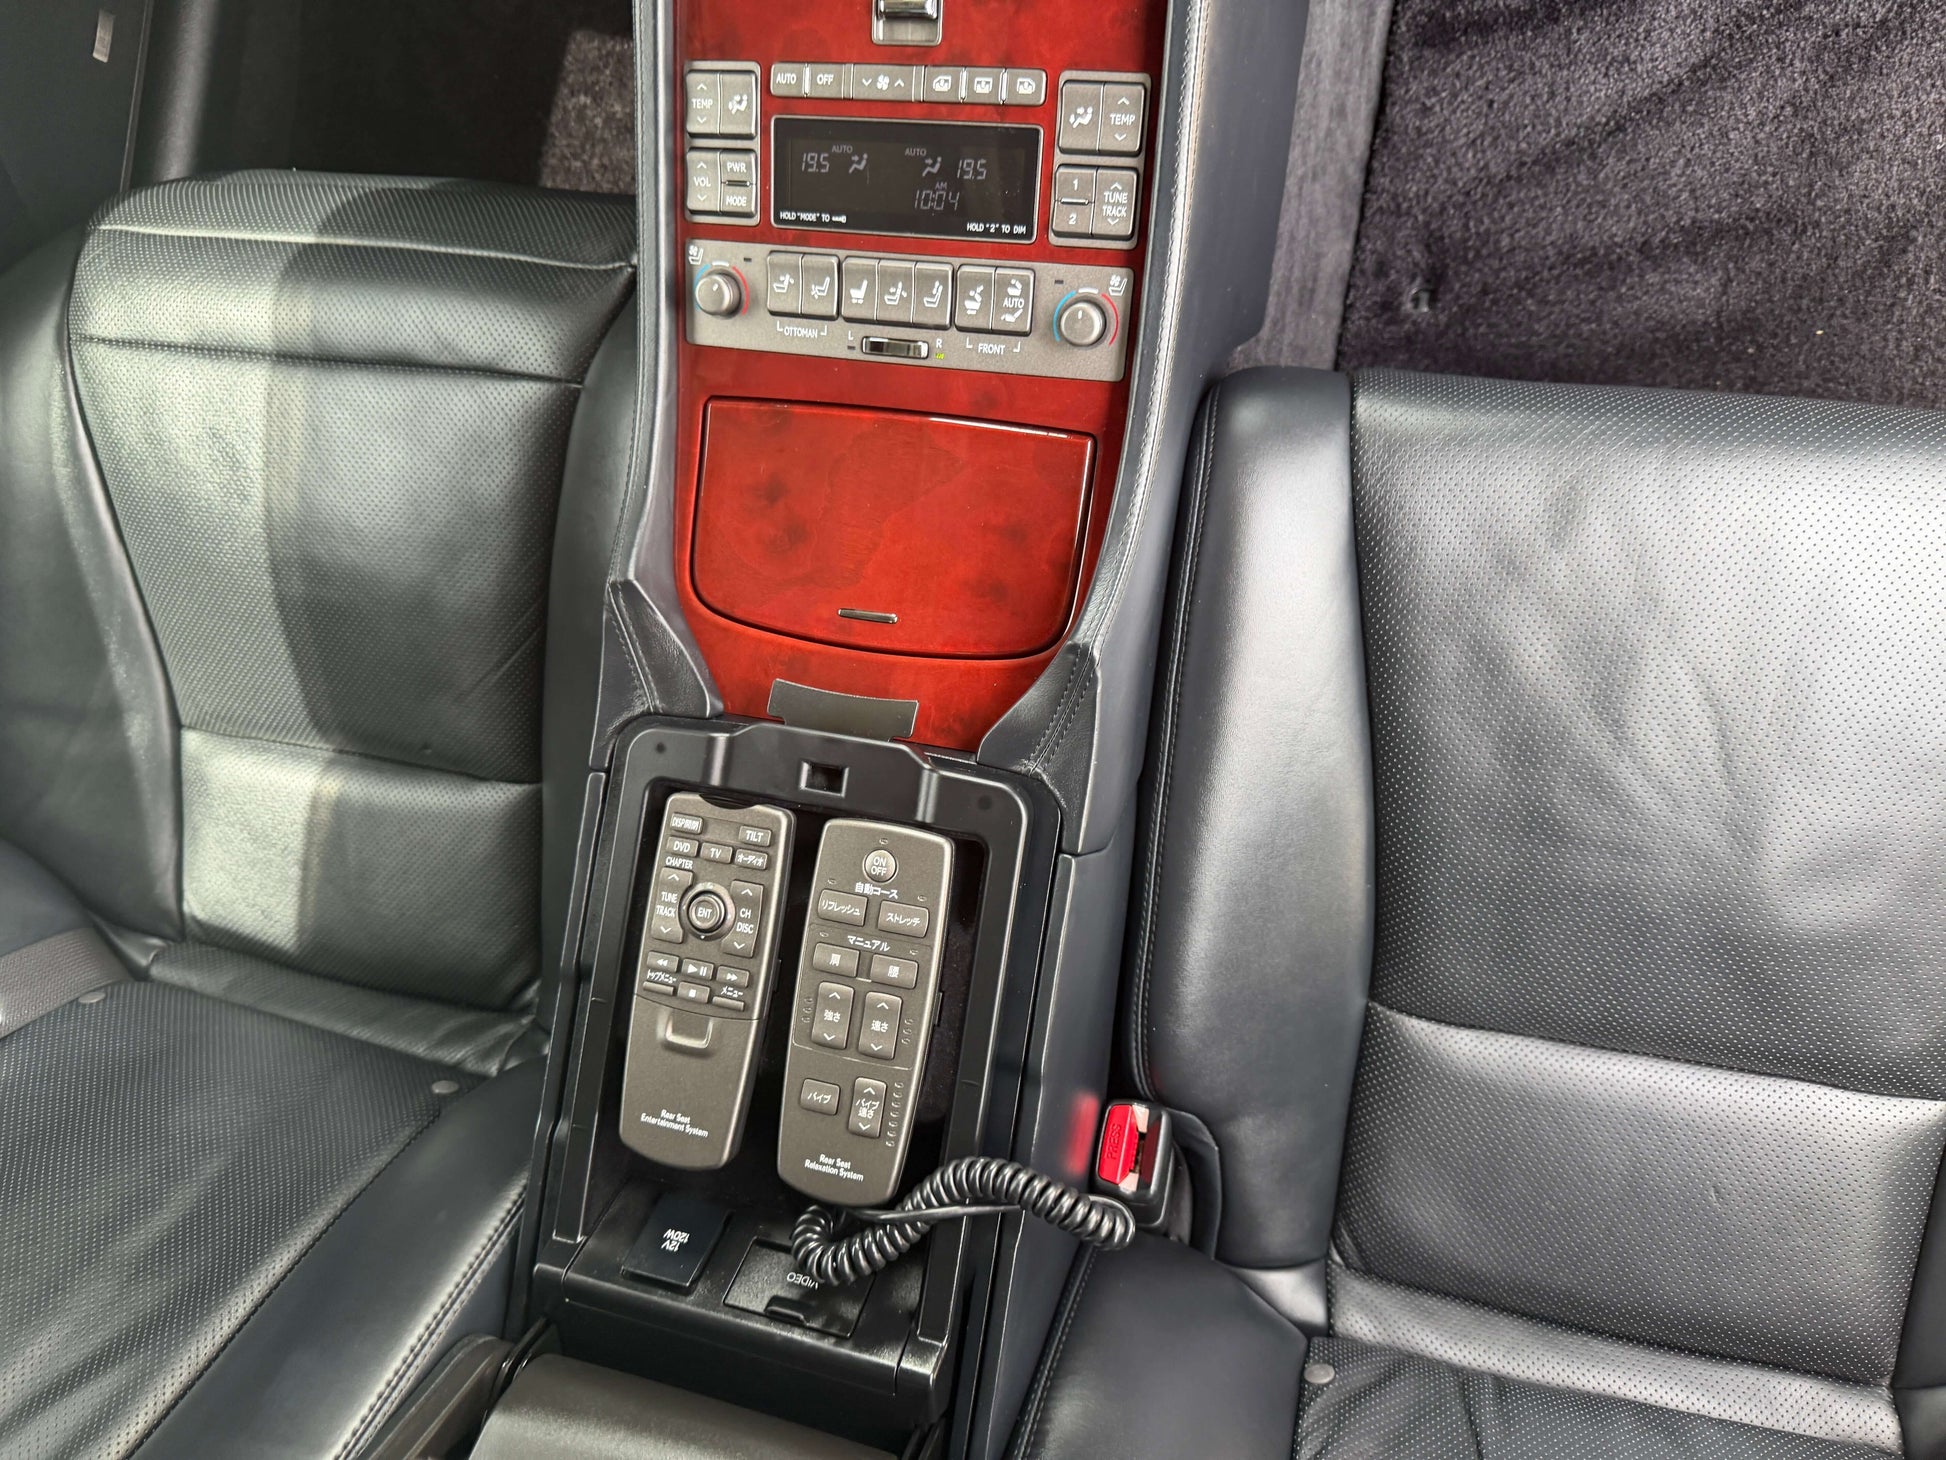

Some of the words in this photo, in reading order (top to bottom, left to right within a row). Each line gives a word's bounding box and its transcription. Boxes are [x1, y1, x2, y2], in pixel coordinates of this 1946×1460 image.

[776, 73, 796, 84] AUTO
[817, 74, 834, 85] OFF
[692, 98, 713, 110] TEMP
[1110, 113, 1135, 126] TEMP
[832, 145, 853, 154] AUTO
[905, 148, 927, 157] AUTO
[727, 161, 746, 172] PWR
[694, 176, 711, 187] VOL
[935, 182, 947, 190] AM
[1072, 179, 1079, 191] 1
[726, 195, 747, 206] MODE
[915, 190, 959, 211] 10:04
[1104, 192, 1128, 204] TUNE
[780, 211, 796, 221] HOLD
[821, 213, 830, 222] TO
[1102, 206, 1127, 218] TRACK
[1069, 214, 1077, 225] 2
[967, 223, 984, 232] HOLD
[1002, 224, 1010, 233] TO
[1013, 225, 1026, 234] DIM
[1003, 297, 1024, 308] AUTO
[784, 327, 818, 339] OTTOMAN
[936, 339, 942, 348] R
[978, 343, 1006, 355] FRONT
[746, 830, 764, 842] TILT
[674, 841, 691, 852] DVD
[710, 848, 722, 858] TV
[666, 856, 693, 870] CHAPTER
[873, 857, 886, 867] ON
[870, 866, 887, 876] OFF
[855, 881, 898, 900] 自動コース
[661, 891, 677, 904] TUNE
[656, 905, 676, 918] TRACK
[697, 908, 713, 919] ENT
[740, 908, 751, 919] CH
[822, 900, 861, 916] リフレッシュ
[886, 912, 921, 927] ストレッチ
[736, 922, 754, 934] DISC
[847, 935, 891, 952] マニュアル
[721, 985, 744, 998] メニュー
[661, 1108, 676, 1121] Rear
[676, 1113, 691, 1124] Seat
[641, 1112, 685, 1132] Entertainment
[684, 1124, 709, 1138] System
[1106, 1123, 1122, 1160] PRESS
[820, 1153, 836, 1165] Rear
[836, 1158, 851, 1169] Seat
[804, 1159, 839, 1176] Relaxation
[839, 1167, 864, 1182] System
[663, 1228, 690, 1244] 120W
[661, 1239, 681, 1252] 12V
[786, 1271, 819, 1290] VIDEO
